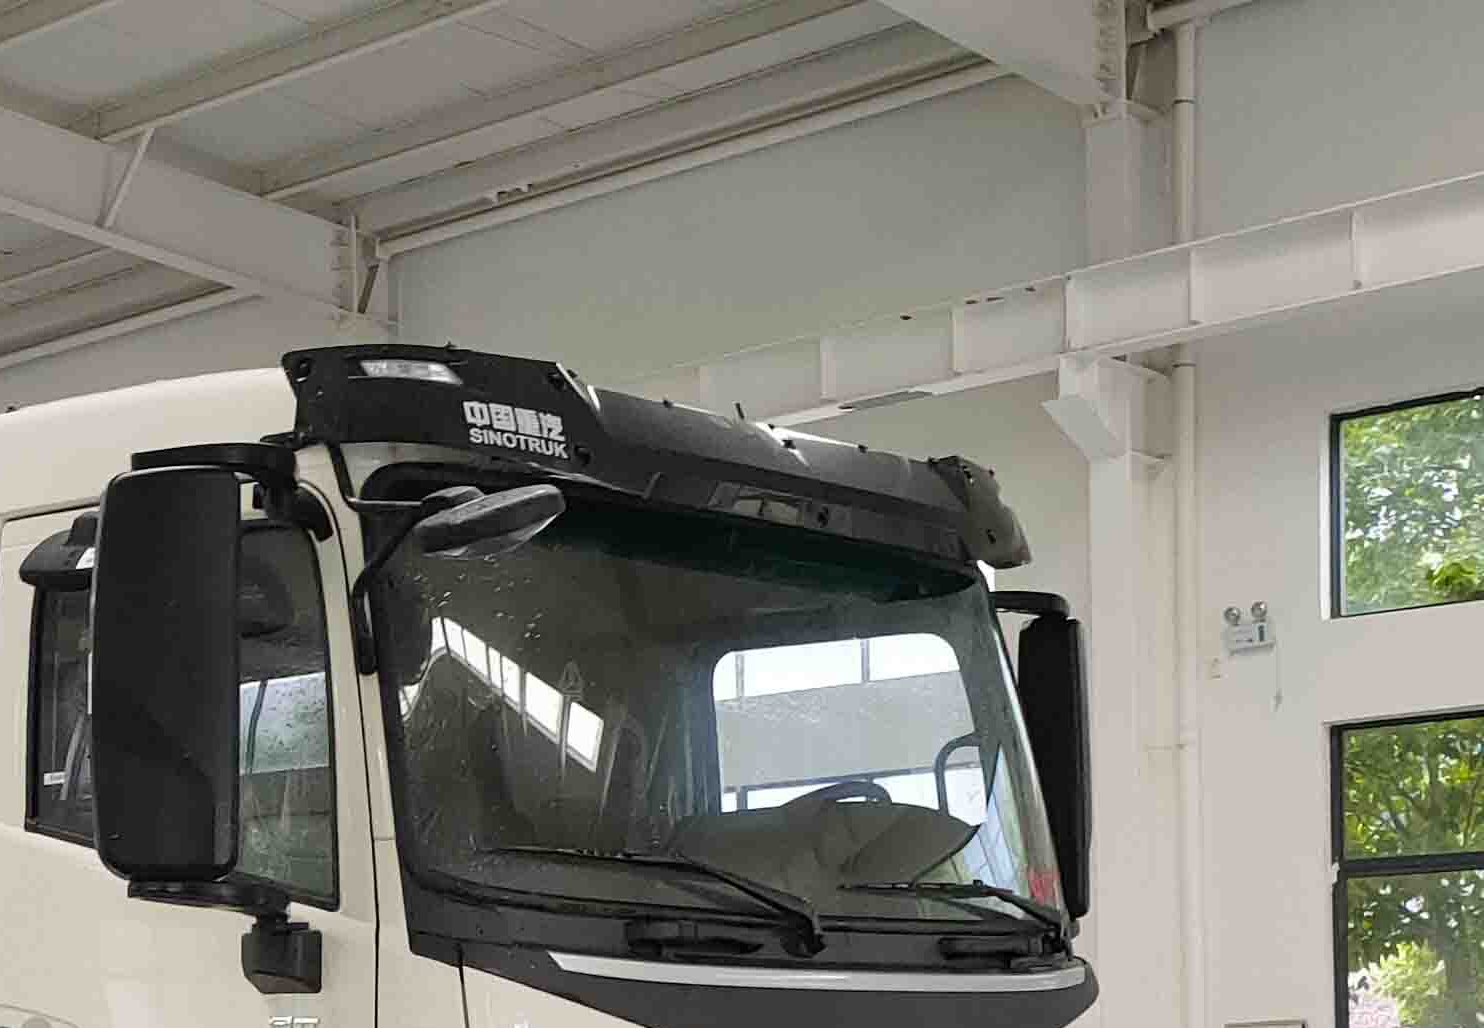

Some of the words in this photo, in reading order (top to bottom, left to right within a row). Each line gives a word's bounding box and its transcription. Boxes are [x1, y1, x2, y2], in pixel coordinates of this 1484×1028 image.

[463, 400, 565, 441] 中国重汽
[469, 427, 569, 459] SINOTRUK
